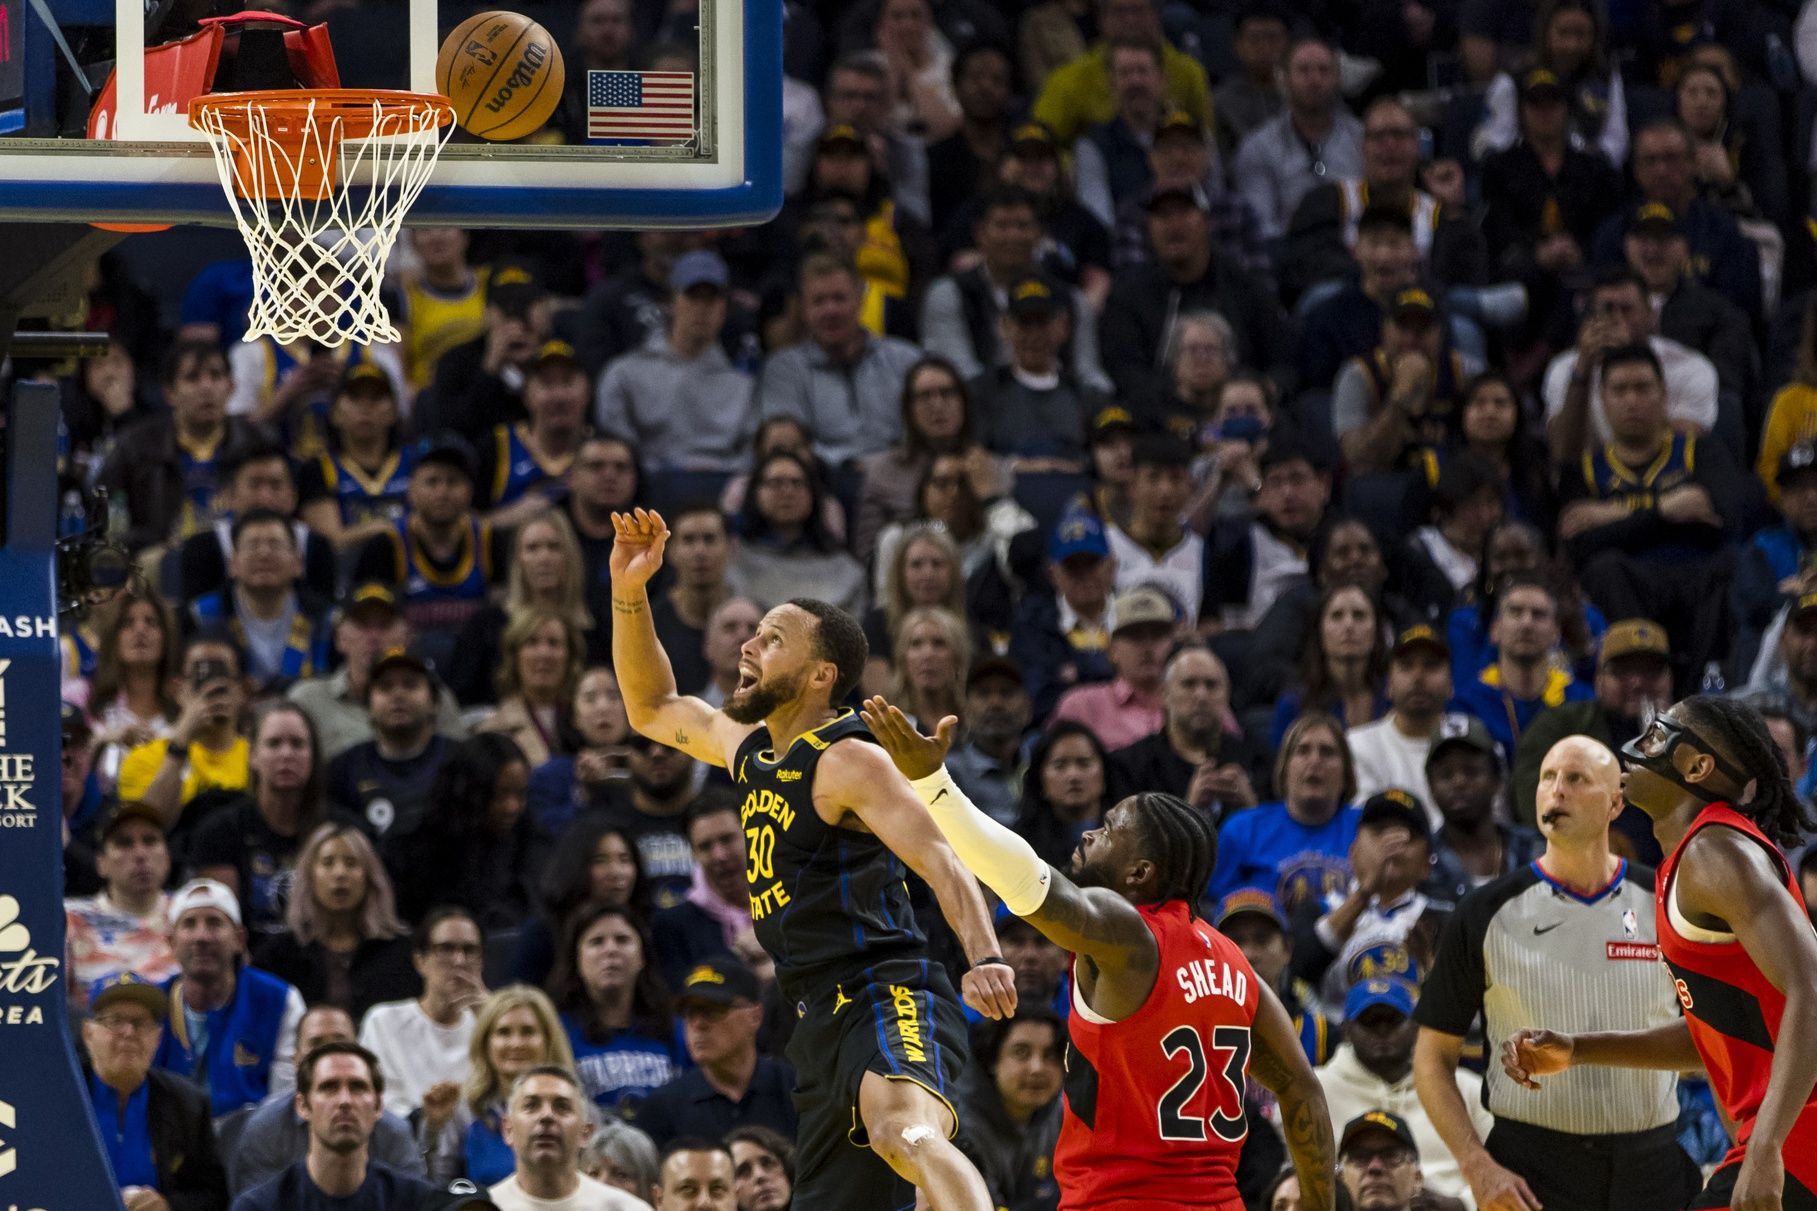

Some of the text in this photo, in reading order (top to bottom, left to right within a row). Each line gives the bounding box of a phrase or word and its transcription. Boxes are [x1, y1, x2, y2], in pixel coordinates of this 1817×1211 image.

[485, 42, 547, 113] Wilson
[746, 824, 776, 884] 30
[749, 880, 791, 921] TATE
[1608, 944, 1657, 958] Emirates
[1176, 959, 1247, 1007] SHEAD
[1158, 1025, 1251, 1142] 23
